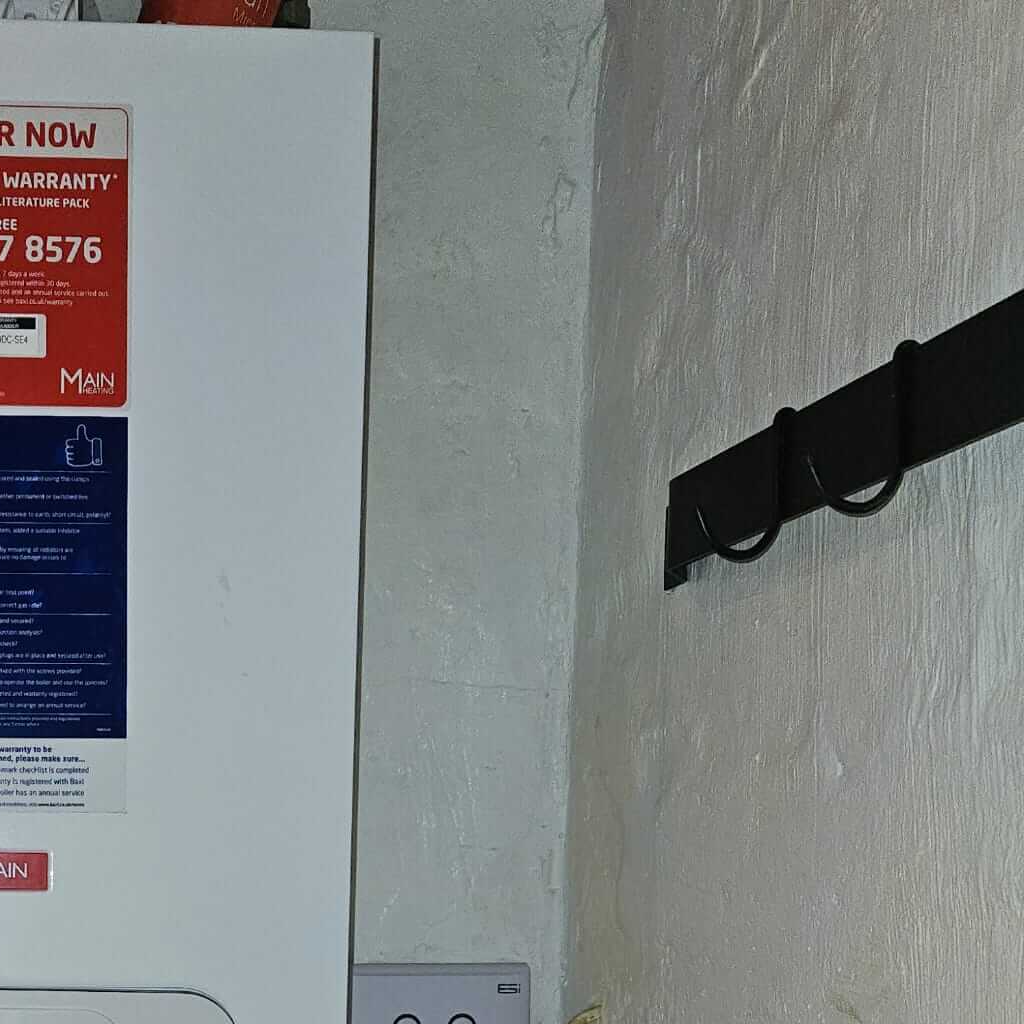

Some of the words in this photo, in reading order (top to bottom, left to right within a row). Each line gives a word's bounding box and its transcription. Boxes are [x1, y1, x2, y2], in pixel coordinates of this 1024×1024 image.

[26, 121, 96, 149] NOW
[63, 198, 90, 209] PACK
[25, 235, 102, 264] 8576
[60, 367, 115, 394] MAIN
[15, 755, 39, 763] please
[56, 767, 89, 775] completed
[19, 778, 52, 786] registered
